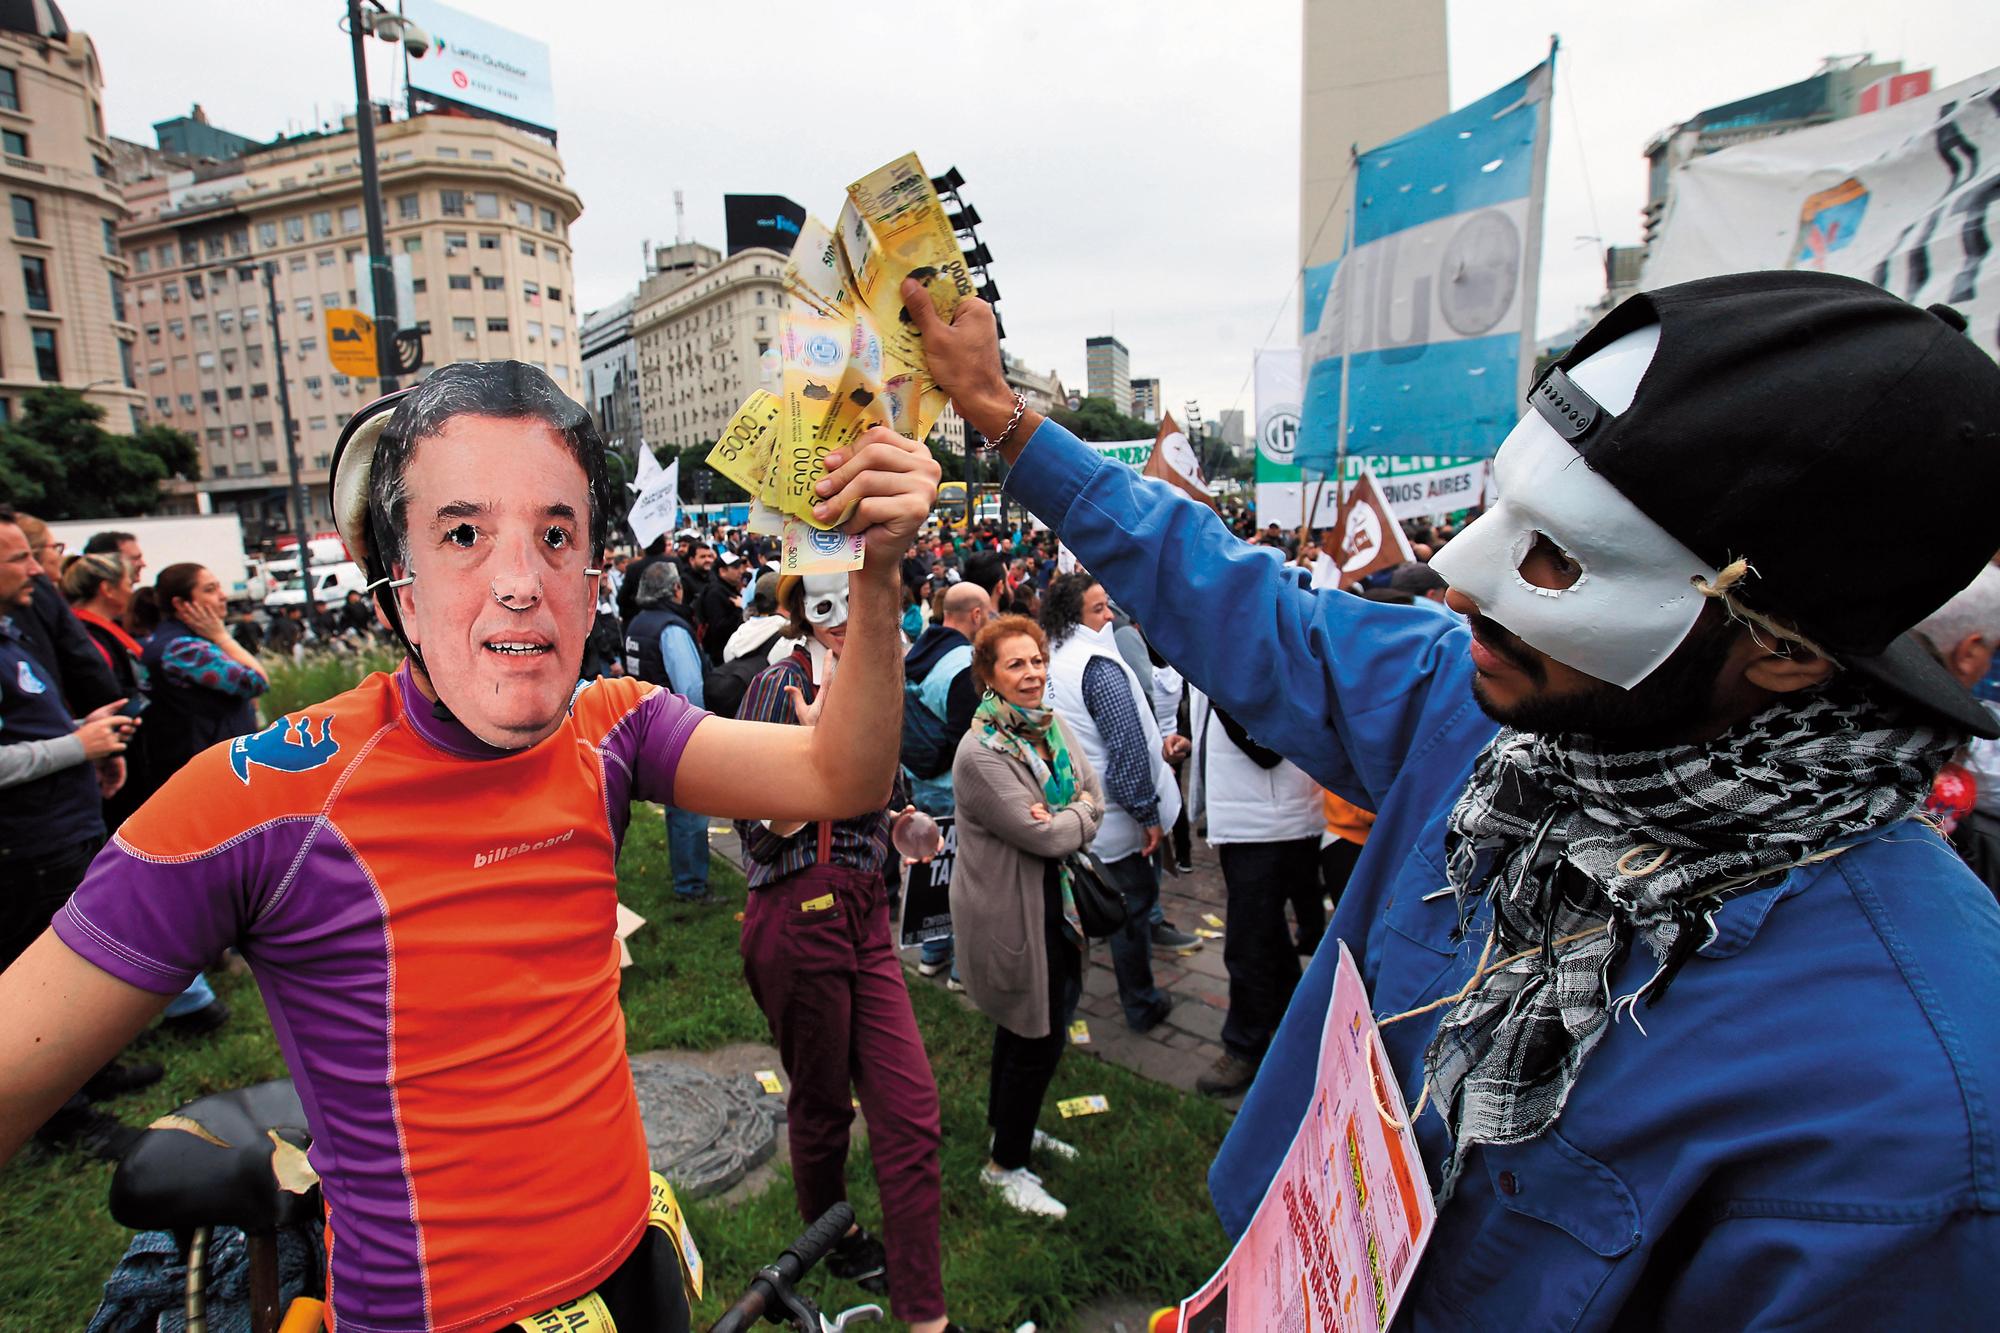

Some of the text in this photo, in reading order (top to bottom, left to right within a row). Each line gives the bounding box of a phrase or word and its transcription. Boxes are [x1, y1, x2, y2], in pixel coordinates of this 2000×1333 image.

[718, 414, 759, 462] 5000
[1427, 473, 1472, 499] AIRES
[788, 546, 798, 569] 5000
[650, 1199, 670, 1214] ZO
